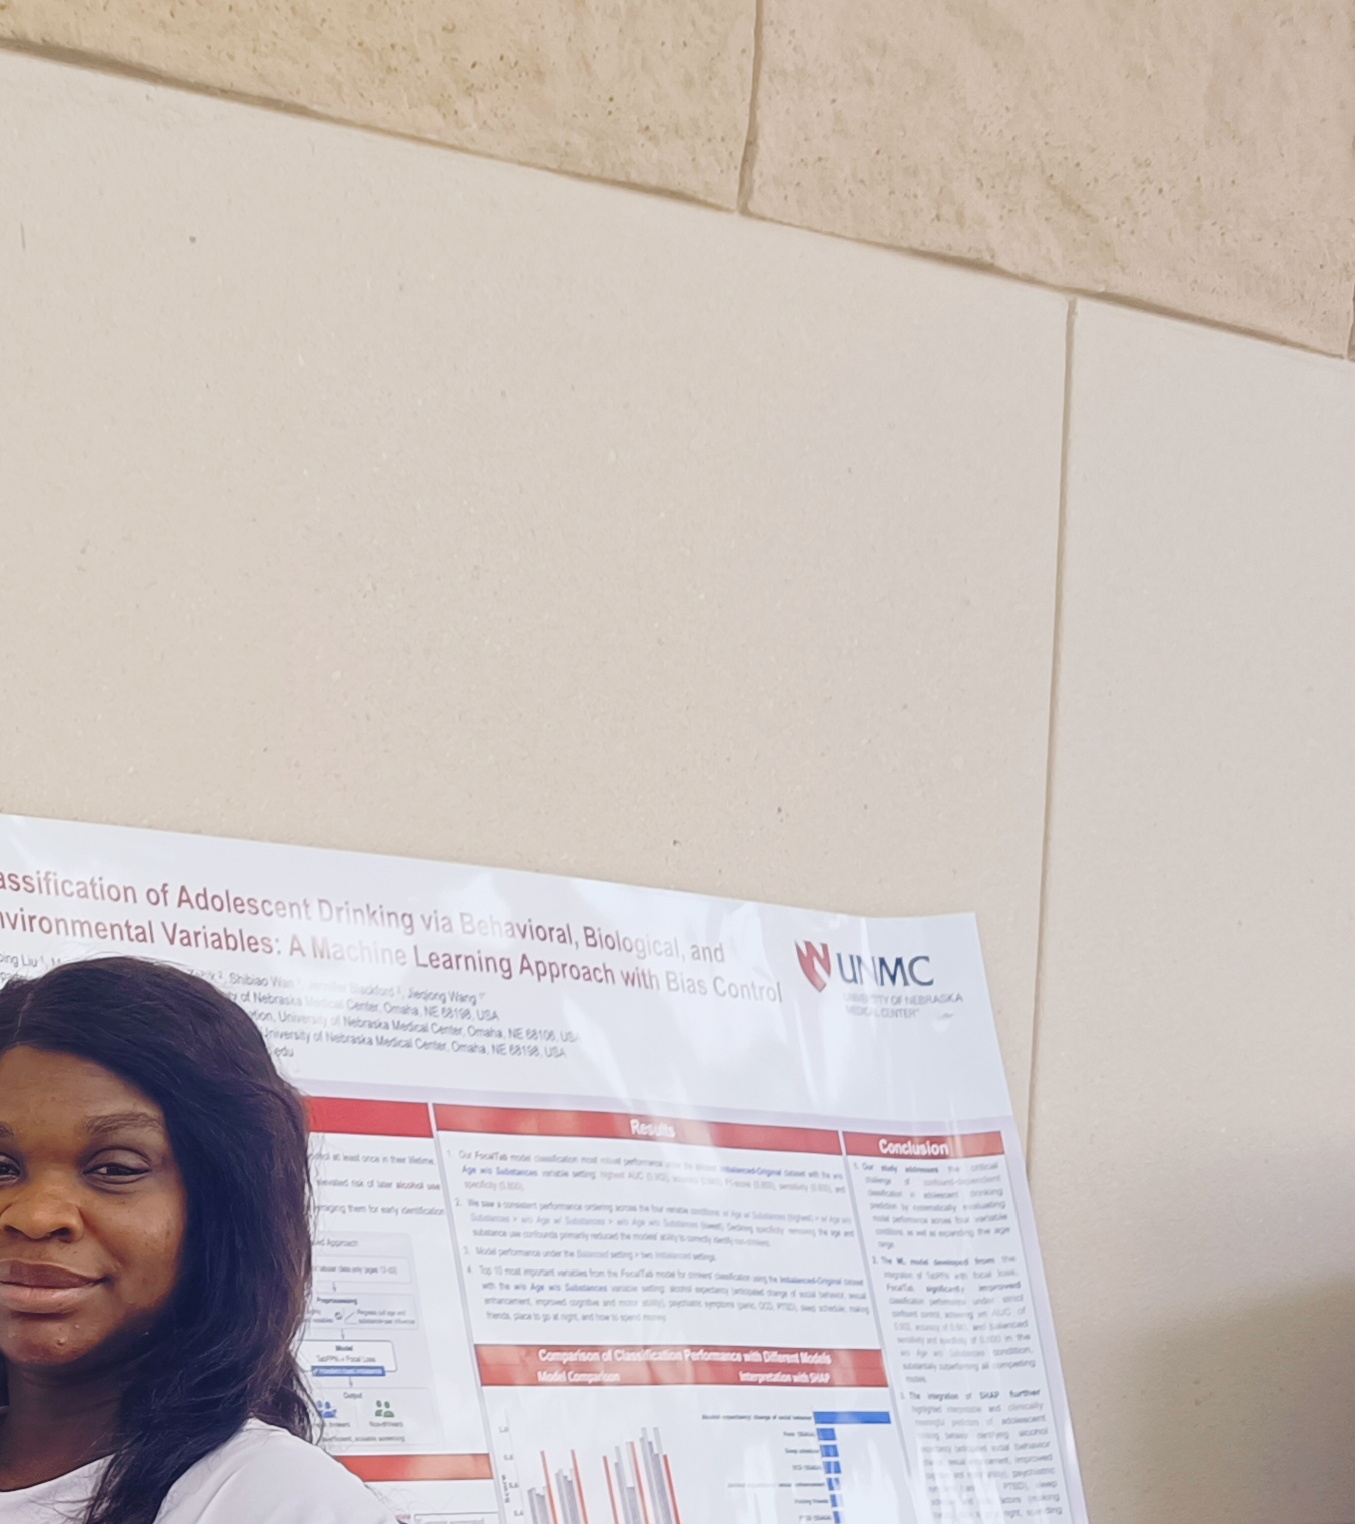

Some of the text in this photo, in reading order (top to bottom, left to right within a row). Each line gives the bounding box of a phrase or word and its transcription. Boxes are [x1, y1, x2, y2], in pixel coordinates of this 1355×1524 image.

[146, 883, 169, 906] of
[178, 885, 311, 922] Adolescent
[318, 898, 415, 936] Drinking
[421, 908, 453, 934] via
[460, 912, 579, 949] Behavioral,
[584, 925, 685, 963] Biological,
[691, 943, 724, 963] and
[161, 921, 281, 956] Variables:
[289, 934, 305, 957] A
[313, 935, 407, 967] Machine
[414, 945, 512, 980] Learning
[519, 954, 615, 985] Approach
[620, 967, 659, 990] with
[666, 970, 707, 995] Bias
[713, 976, 782, 1003] Control
[837, 953, 933, 986] UNMC
[630, 1119, 675, 1138] Results
[879, 1139, 948, 1155] Conclusion
